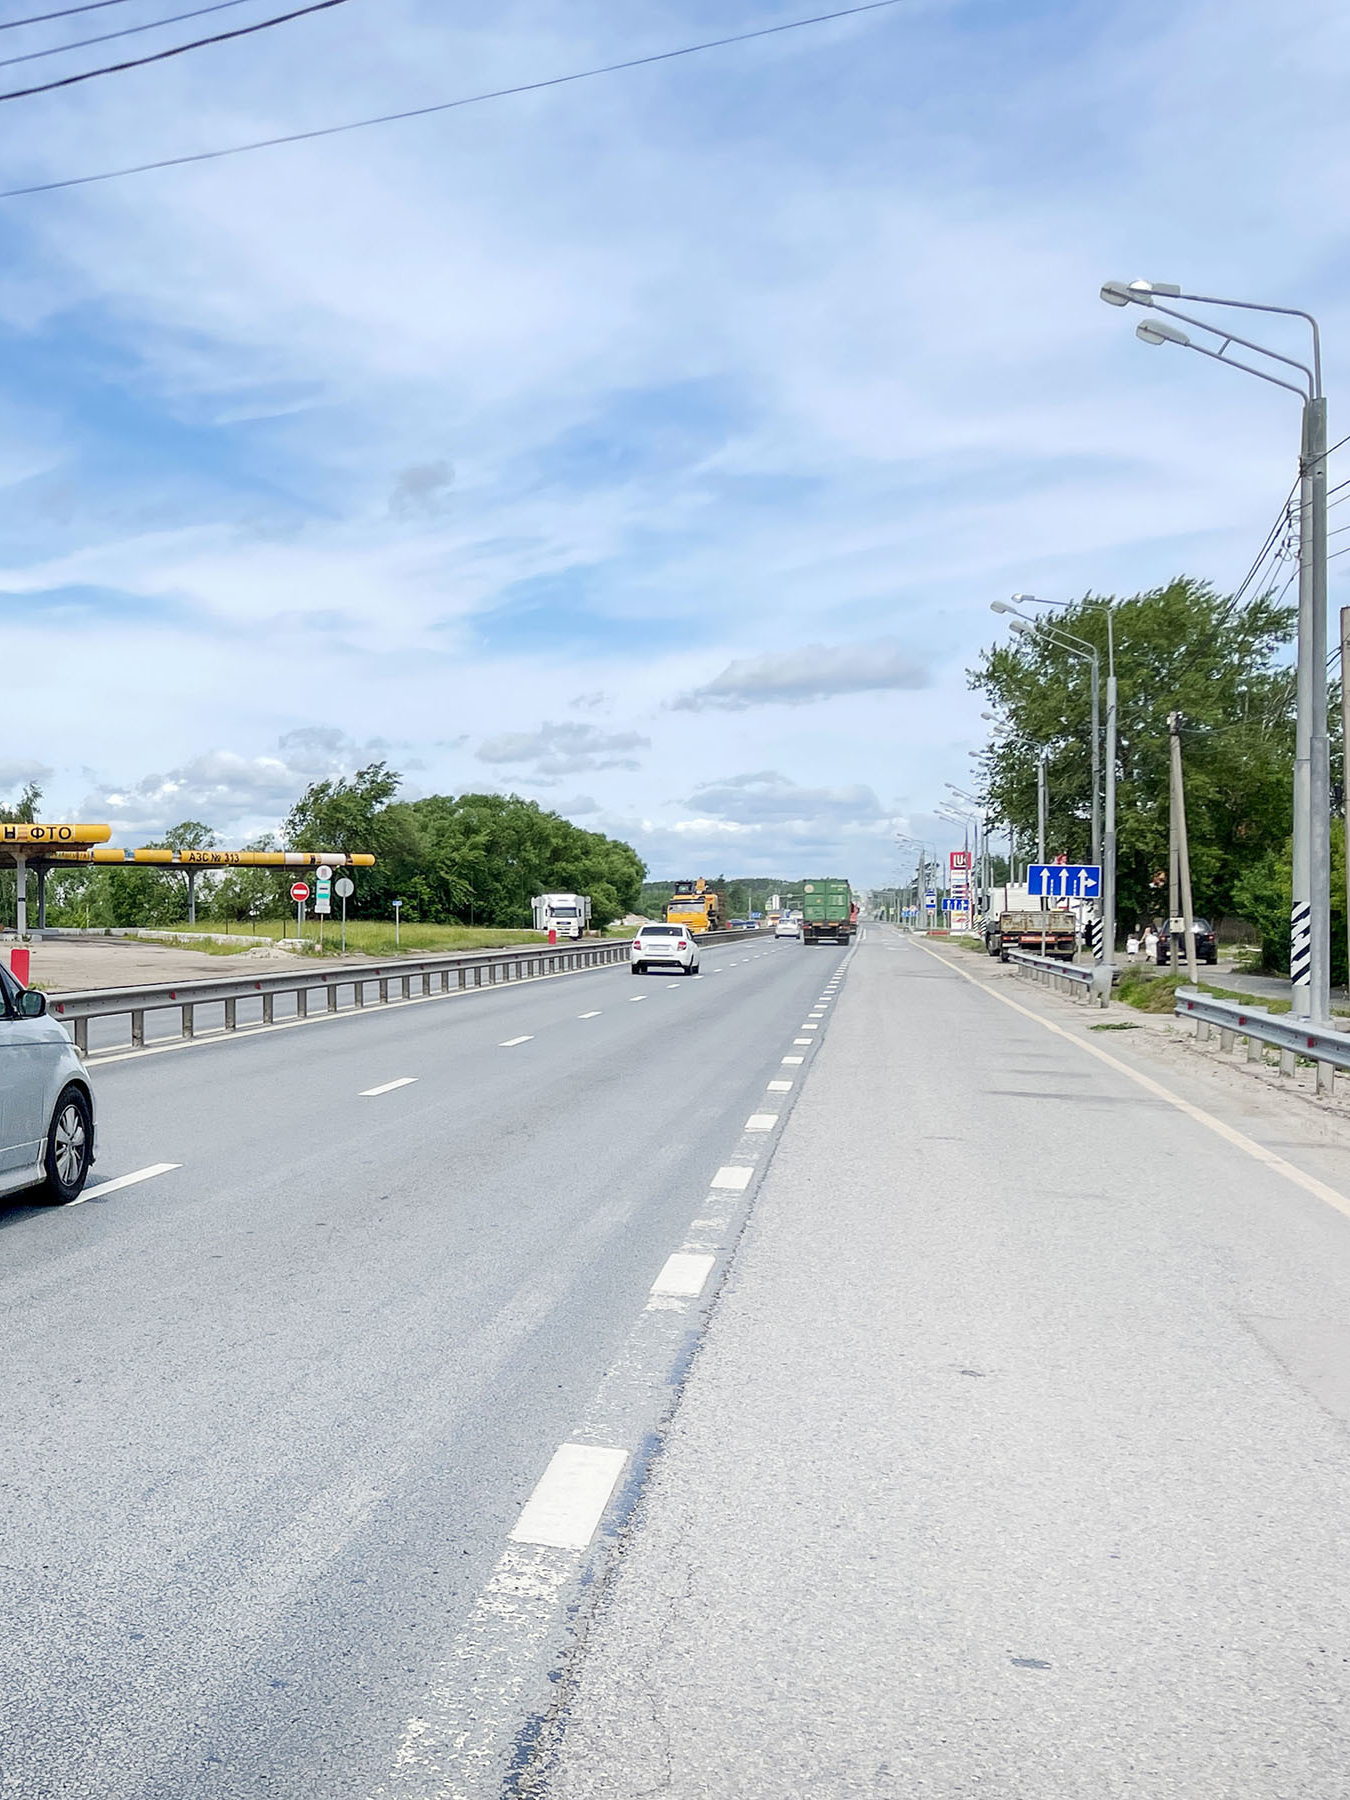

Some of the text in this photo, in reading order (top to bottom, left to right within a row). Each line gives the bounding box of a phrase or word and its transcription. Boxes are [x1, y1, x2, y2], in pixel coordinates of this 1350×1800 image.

[189, 852, 240, 863] АЗС № 313
